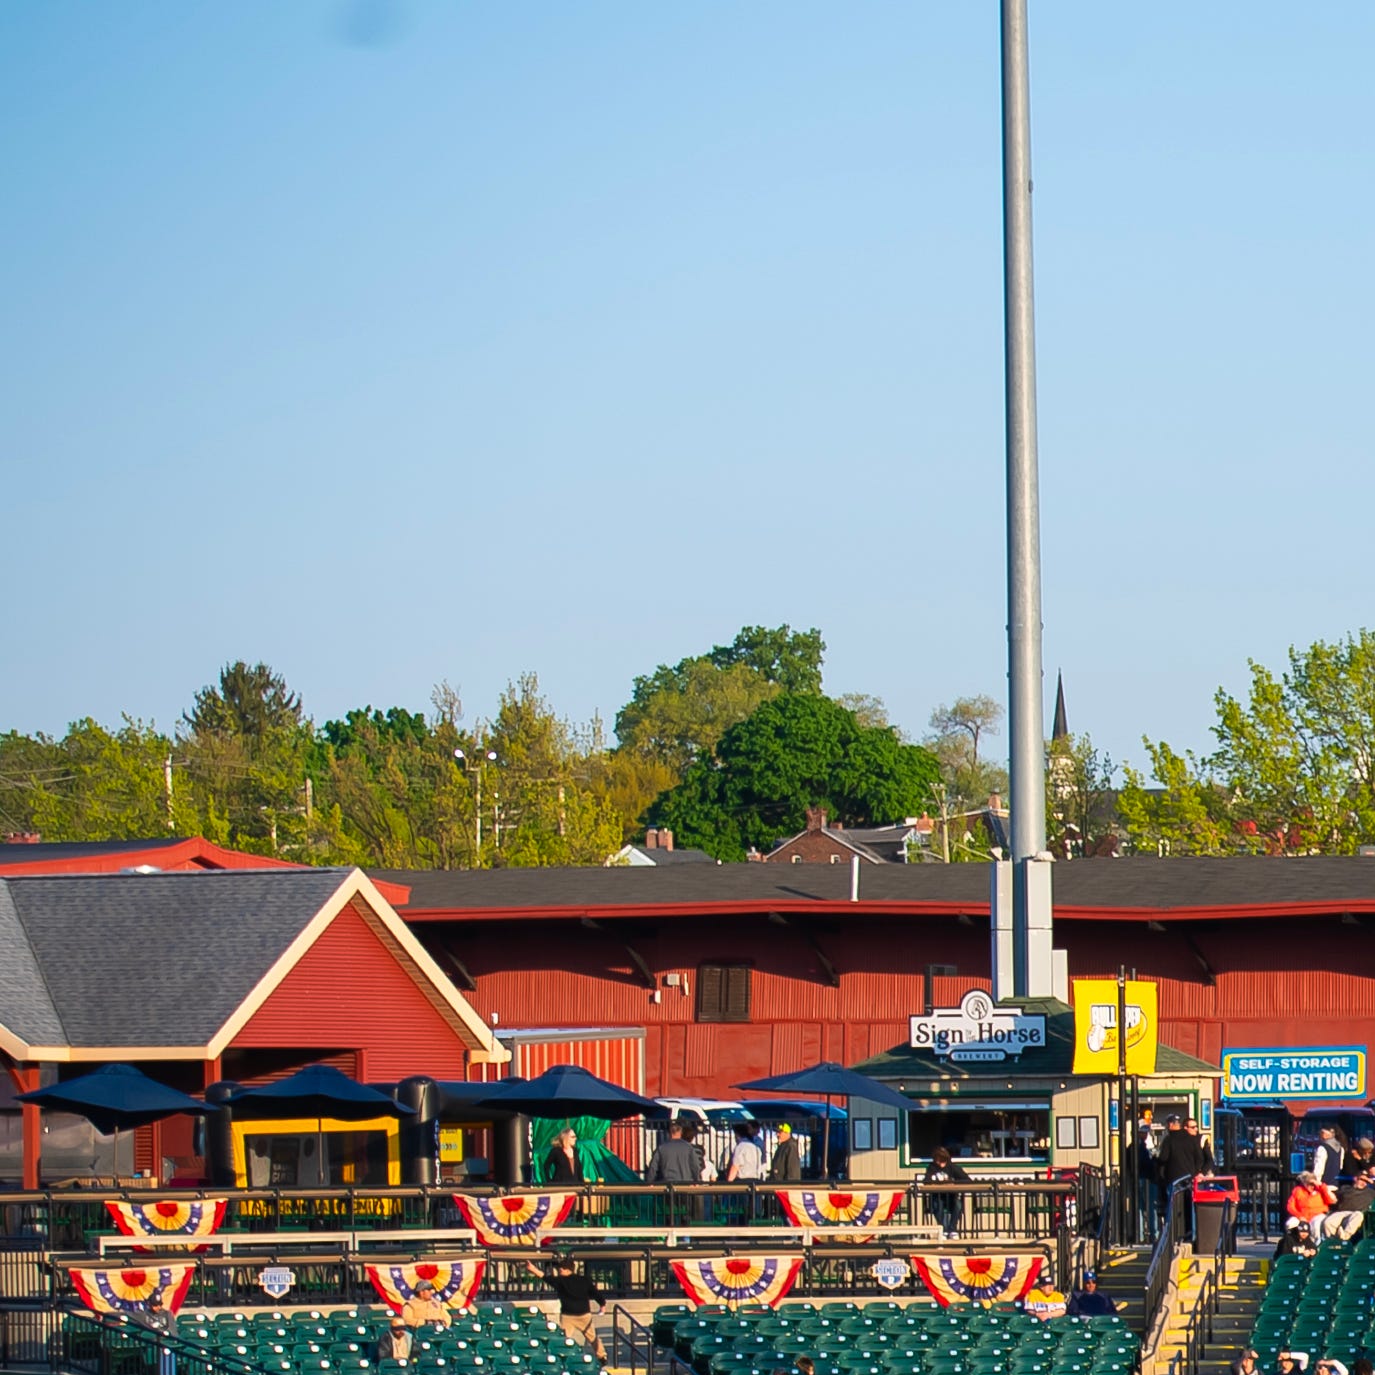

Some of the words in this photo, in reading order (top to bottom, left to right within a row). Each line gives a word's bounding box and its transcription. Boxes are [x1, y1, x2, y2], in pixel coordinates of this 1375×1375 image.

[916, 1022, 963, 1050] Sign
[978, 1022, 1041, 1043] Horse
[1239, 1057, 1350, 1070] SELF-STORAGE
[1230, 1074, 1273, 1093] NOW
[1278, 1072, 1358, 1091] RENTING
